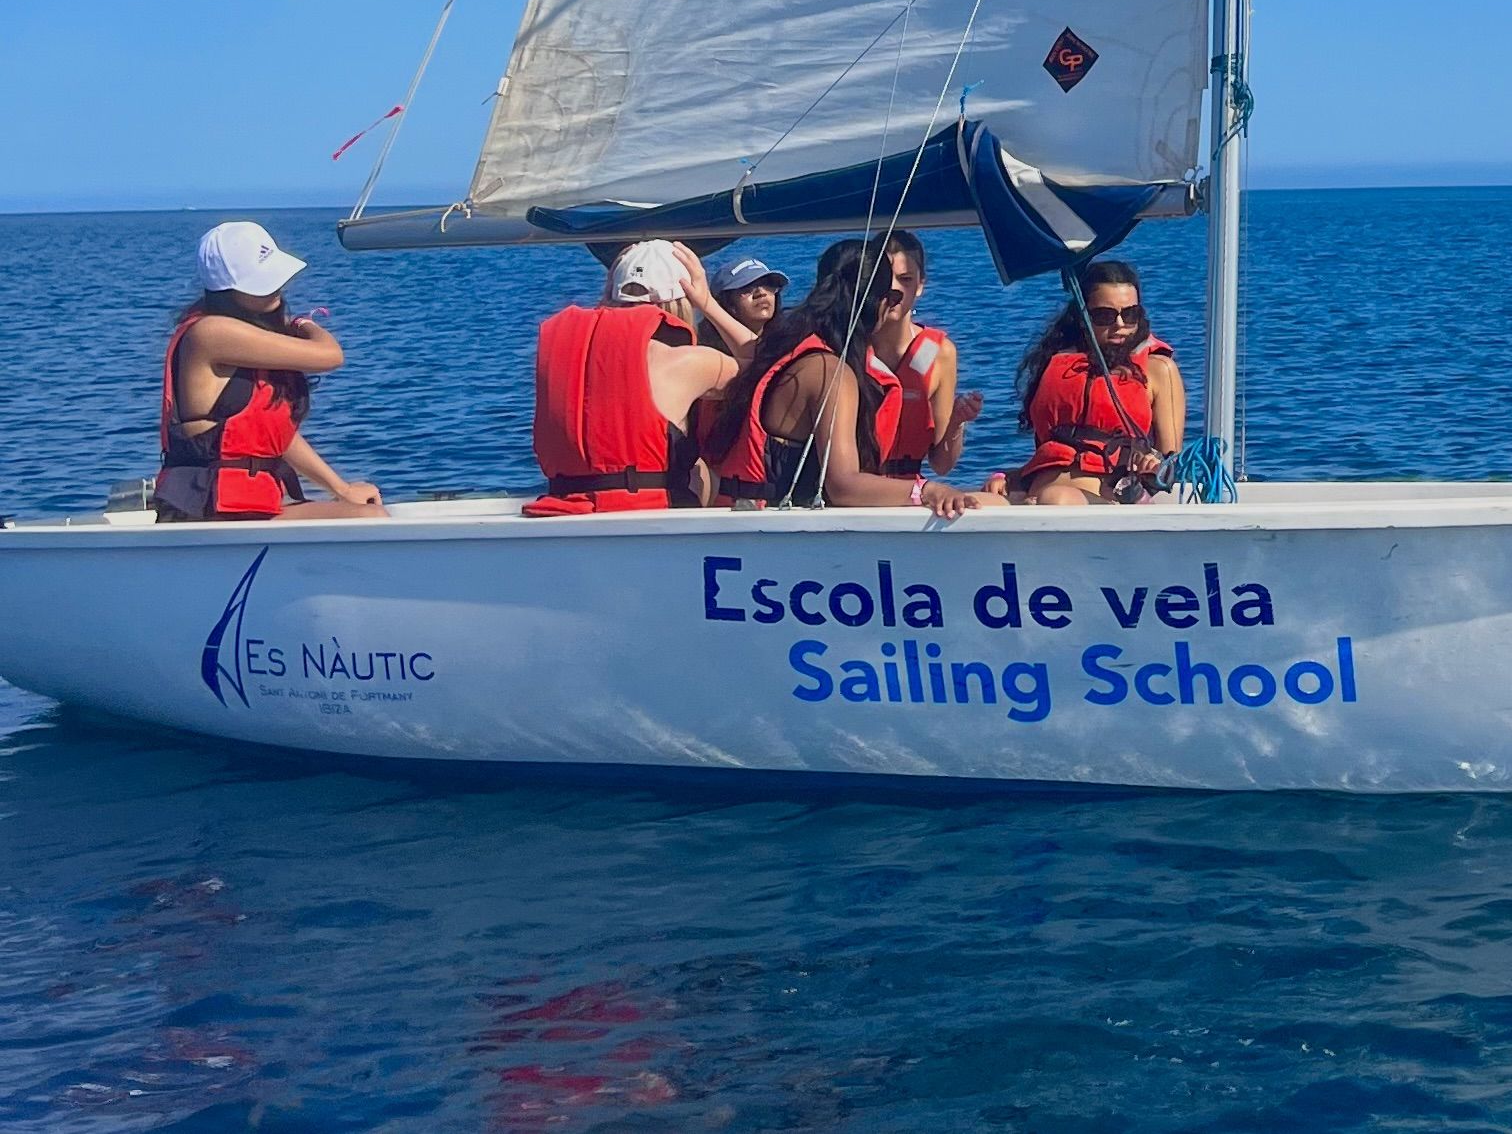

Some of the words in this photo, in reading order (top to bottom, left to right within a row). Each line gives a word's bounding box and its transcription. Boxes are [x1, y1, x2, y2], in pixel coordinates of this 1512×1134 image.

[703, 555, 943, 628] Escola
[973, 562, 1073, 629] de
[1100, 563, 1275, 629] vela
[302, 636, 435, 681] NÀUTIC
[788, 639, 1053, 723] Sailing
[1083, 637, 1357, 707] School
